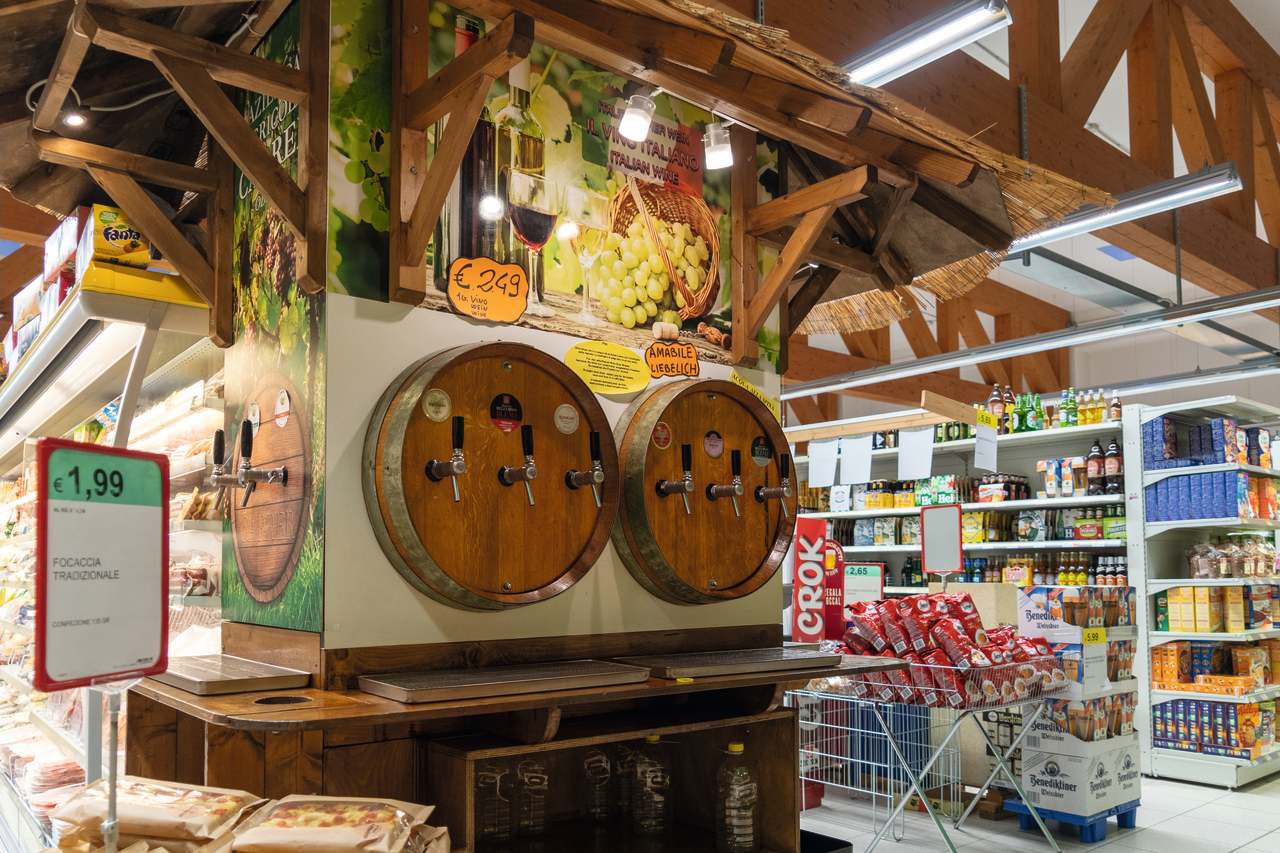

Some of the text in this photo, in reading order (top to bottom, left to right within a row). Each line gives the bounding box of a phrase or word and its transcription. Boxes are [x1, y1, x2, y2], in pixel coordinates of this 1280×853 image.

[586, 118, 600, 138] IL
[640, 137, 700, 172] ITALIANO
[609, 150, 679, 186] ITALIAN WINE
[103, 225, 142, 242] Fanta
[453, 263, 472, 289] €
[649, 346, 694, 359] AMABILE
[650, 362, 697, 375] LIEBELICH
[53, 465, 124, 501] € 1,99
[53, 557, 102, 568] FOCACCIA
[53, 569, 121, 580] TRADIZIONALE
[849, 566, 868, 577] 2,65
[797, 535, 824, 635] CROK
[824, 587, 842, 597] EGALA
[1029, 774, 1077, 792] Benediktiner
